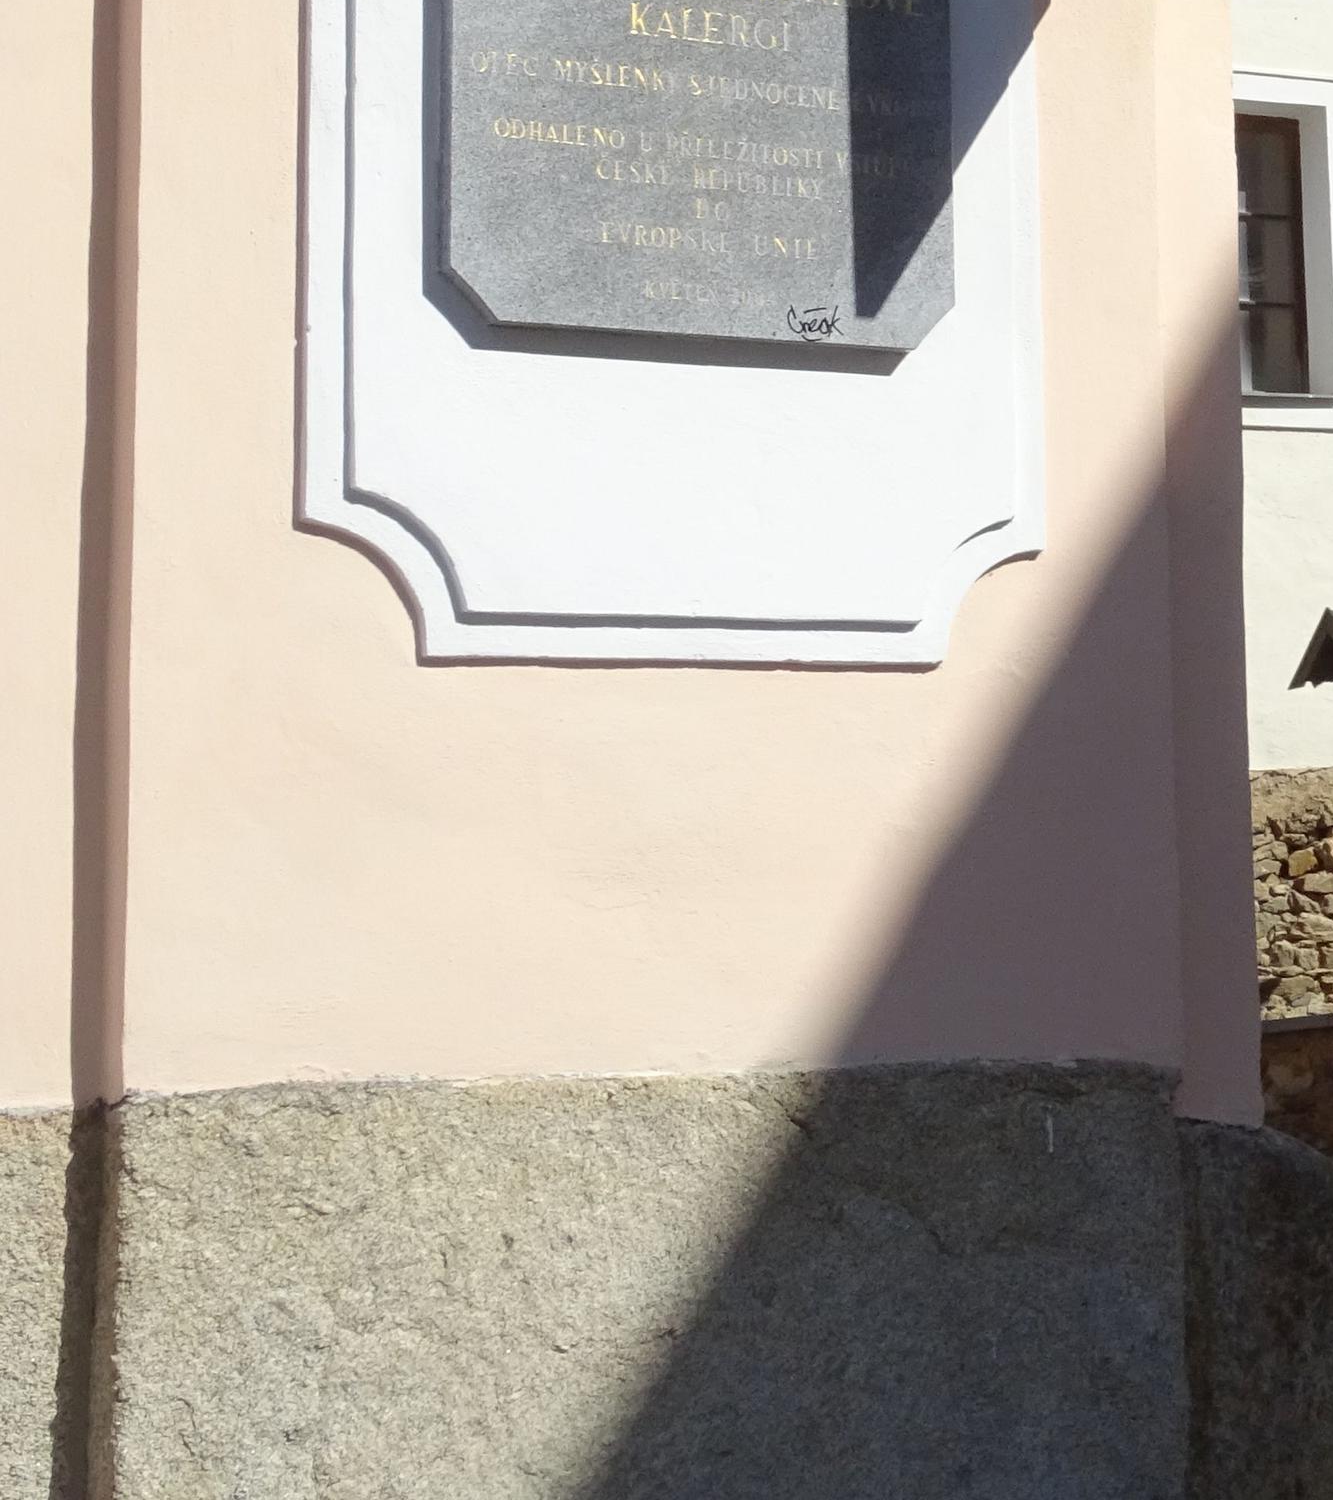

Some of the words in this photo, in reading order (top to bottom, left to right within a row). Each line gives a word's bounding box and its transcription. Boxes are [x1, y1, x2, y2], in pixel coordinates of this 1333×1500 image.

[629, 1, 791, 52] KALERGI
[494, 116, 626, 150] ODHALENO
[693, 164, 824, 201] REPUBLIKY
[753, 234, 817, 261] UNIE
